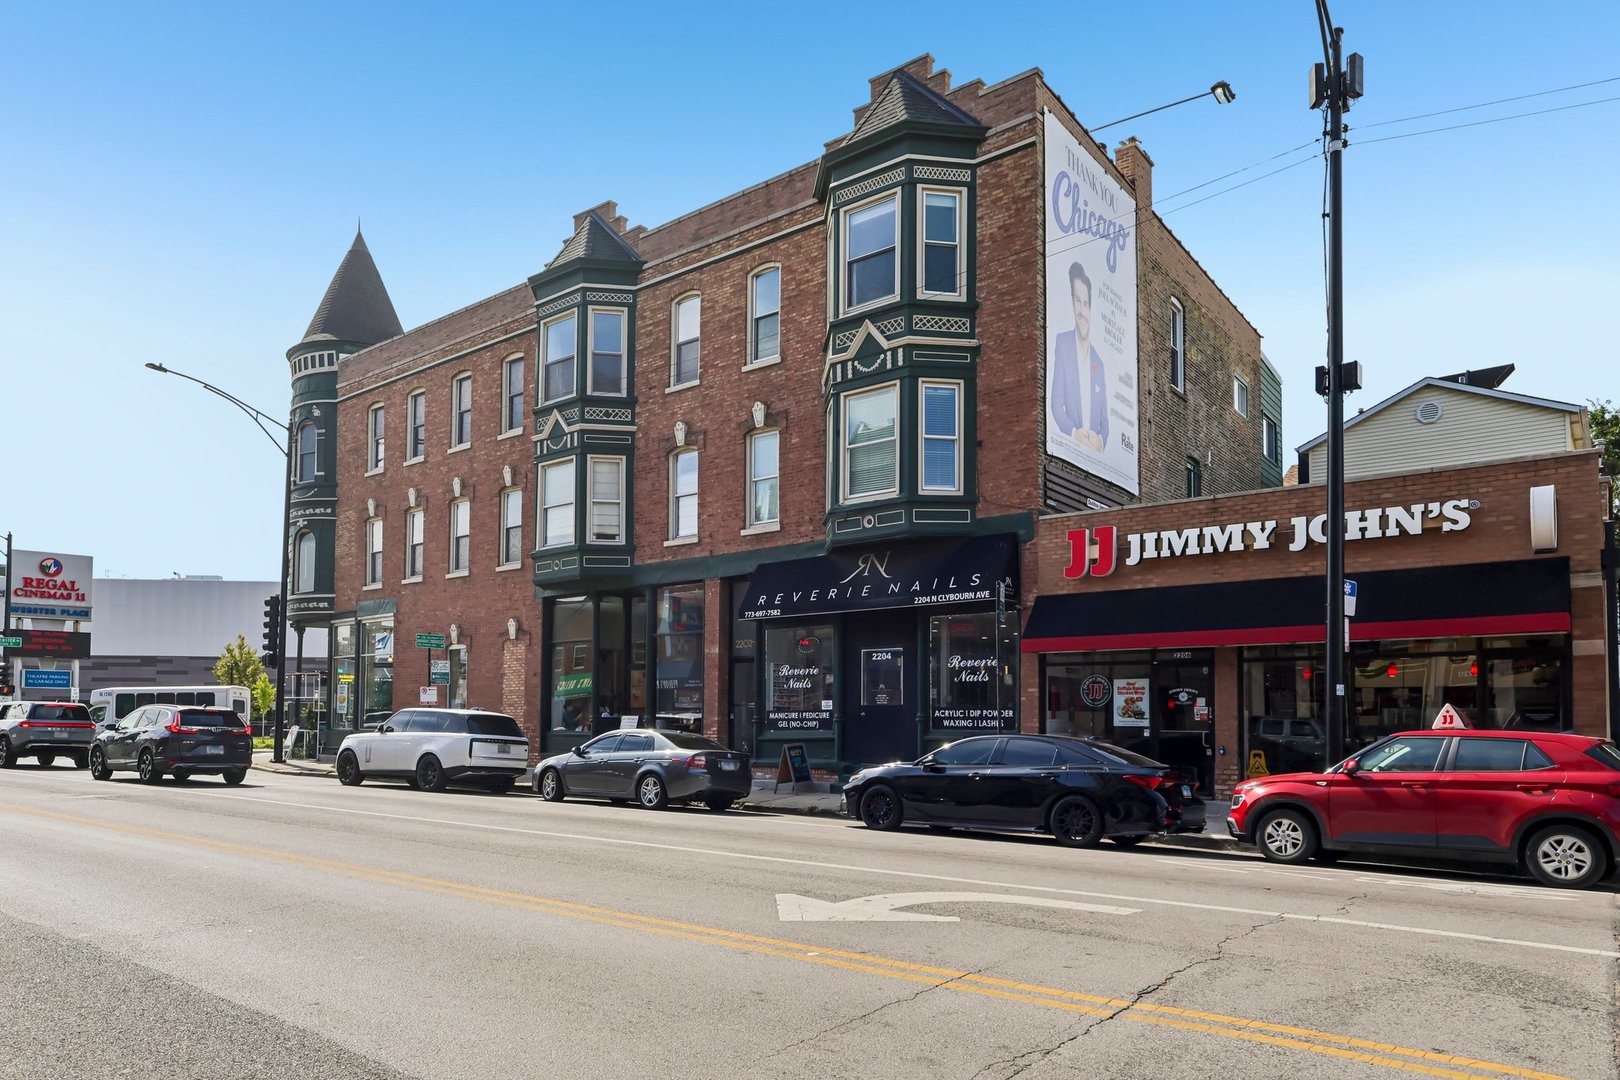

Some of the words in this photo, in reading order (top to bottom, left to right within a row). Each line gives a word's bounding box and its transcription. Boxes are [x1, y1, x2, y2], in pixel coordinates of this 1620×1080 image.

[1065, 146, 1099, 196] THANK
[1099, 181, 1117, 213] YOU
[1052, 170, 1130, 273] Chicago
[1126, 520, 1277, 566] JIMMY
[1289, 498, 1472, 552] JOHN'S
[1064, 525, 1117, 579] JJ
[22, 577, 80, 592] REGAL
[757, 584, 872, 606] REVERIE
[888, 573, 981, 594] NAILS
[13, 587, 72, 601] CINEMAS
[75, 593, 86, 602] 11
[914, 596, 931, 604] 2204
[938, 592, 975, 602] CLYBOURN
[975, 590, 990, 599] AVE
[61, 609, 89, 617] PLACE
[744, 609, 781, 618] 773-697-7582
[872, 652, 892, 660] 2204
[947, 655, 998, 668] Reverie
[779, 664, 820, 676] Reverie
[954, 670, 989, 683] Nails
[783, 677, 812, 689] Nails
[1089, 683, 1104, 699] JJ
[777, 720, 788, 728] GEL
[789, 720, 819, 729] (NO-CHIP)
[943, 719, 973, 727] WAXING
[978, 719, 1004, 727] LASHS
[1441, 714, 1454, 725] JJ
